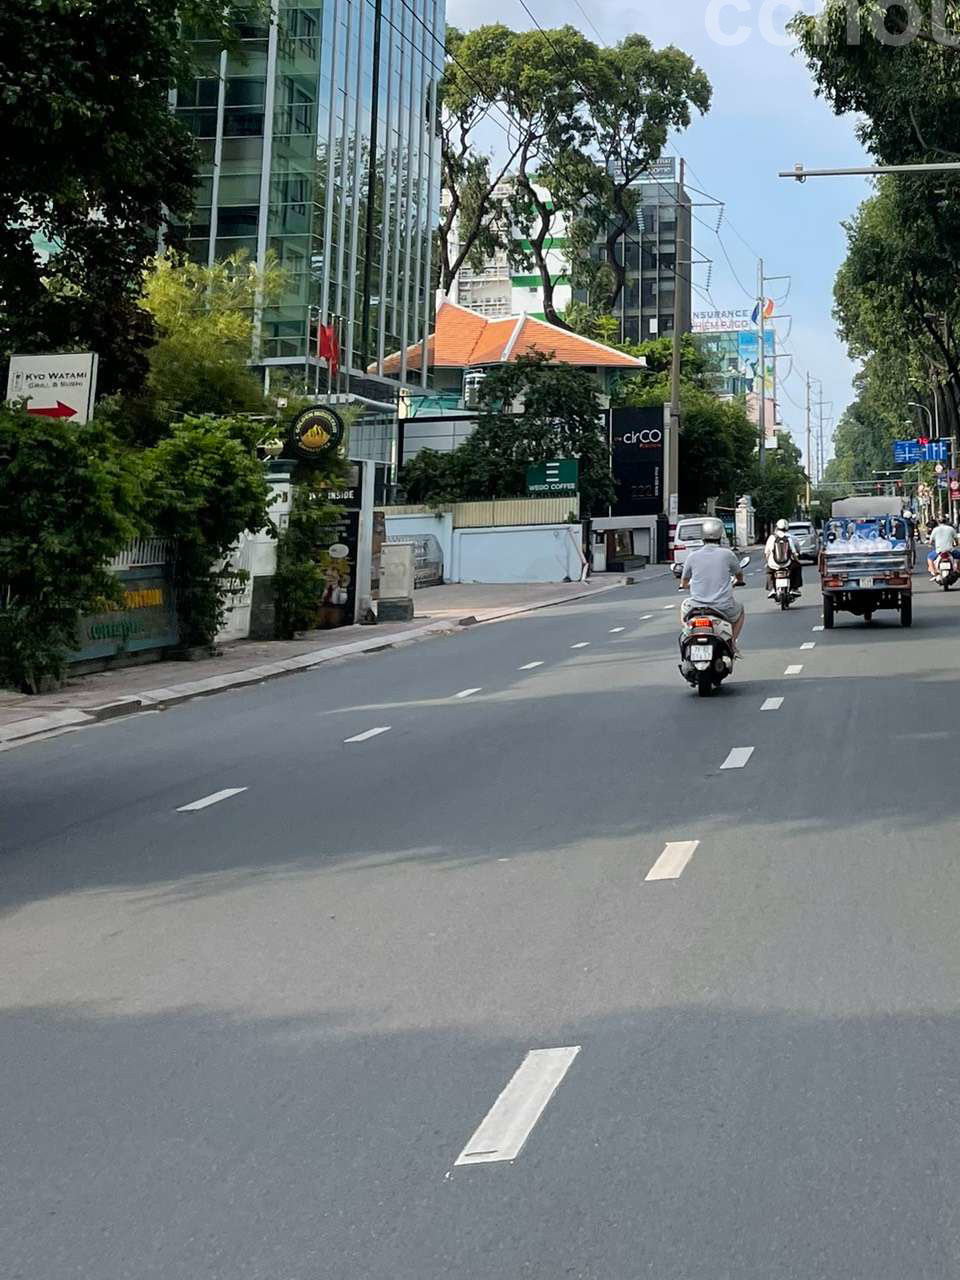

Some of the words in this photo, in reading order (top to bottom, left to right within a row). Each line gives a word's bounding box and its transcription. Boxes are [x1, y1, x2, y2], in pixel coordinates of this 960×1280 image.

[693, 310, 749, 320] NSURANCE
[25, 373, 46, 381] KYO
[48, 371, 87, 380] WATAMI
[327, 490, 355, 500] INSIDE
